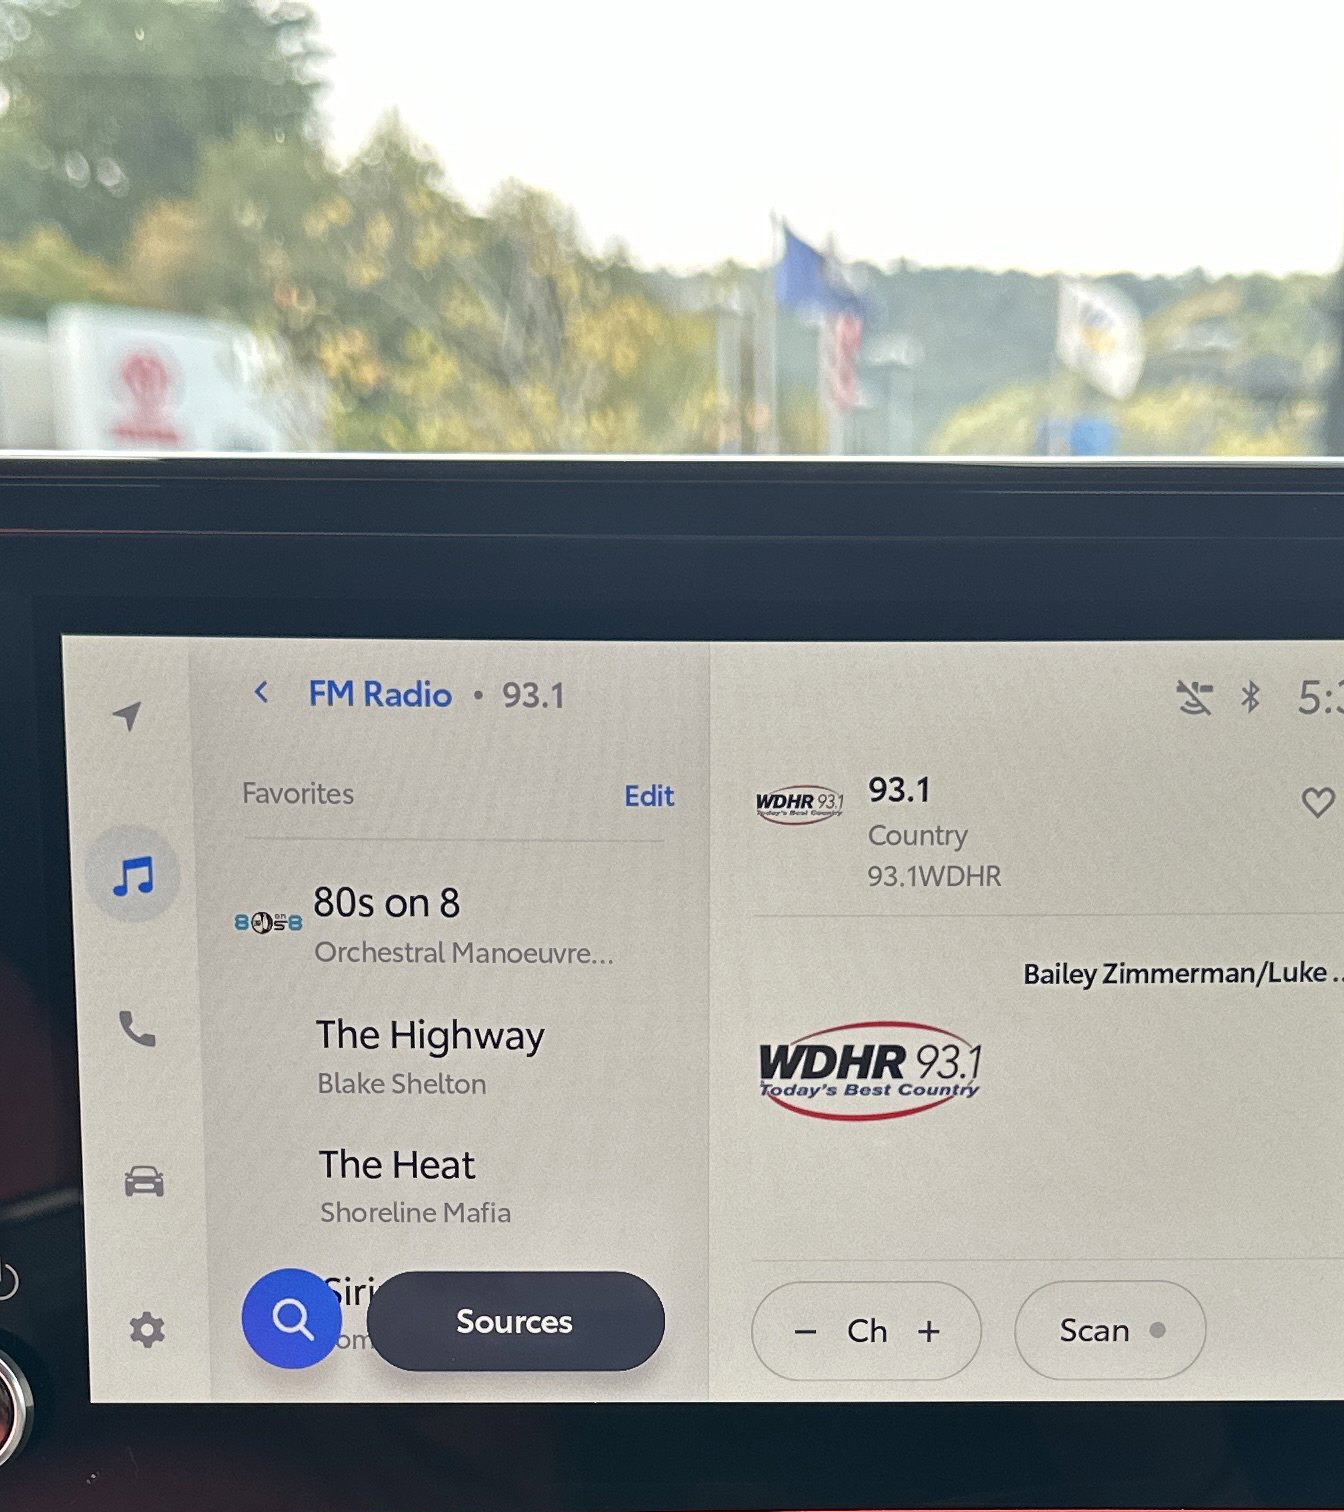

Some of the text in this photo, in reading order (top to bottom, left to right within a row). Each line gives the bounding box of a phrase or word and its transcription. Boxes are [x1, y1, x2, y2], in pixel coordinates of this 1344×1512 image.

[309, 679, 565, 709] FM Radio 93.1
[243, 781, 355, 806] Favorites
[625, 785, 675, 808] Edit
[756, 794, 844, 810] WDHR 93.1
[868, 776, 929, 802] 93.1
[868, 824, 968, 852] Country
[868, 865, 1002, 887] 93.1WDHR
[314, 886, 460, 918] 80s on 8
[314, 940, 614, 966] Orchestral Manoeuvre...
[1024, 962, 1327, 990] Bailey Zimmerman/Luke
[316, 1019, 545, 1057] The Highway
[760, 1044, 982, 1079] WDHR 93.1
[317, 1072, 487, 1096] Blake Shelton
[759, 1083, 980, 1099] Today's Best Country
[319, 1150, 476, 1180] The Heat
[320, 1201, 512, 1224] Shoreline Mafia
[325, 1276, 380, 1306] Siri
[455, 1308, 573, 1335] Sources
[847, 1318, 888, 1344] Ch
[1060, 1317, 1130, 1344] Scan
